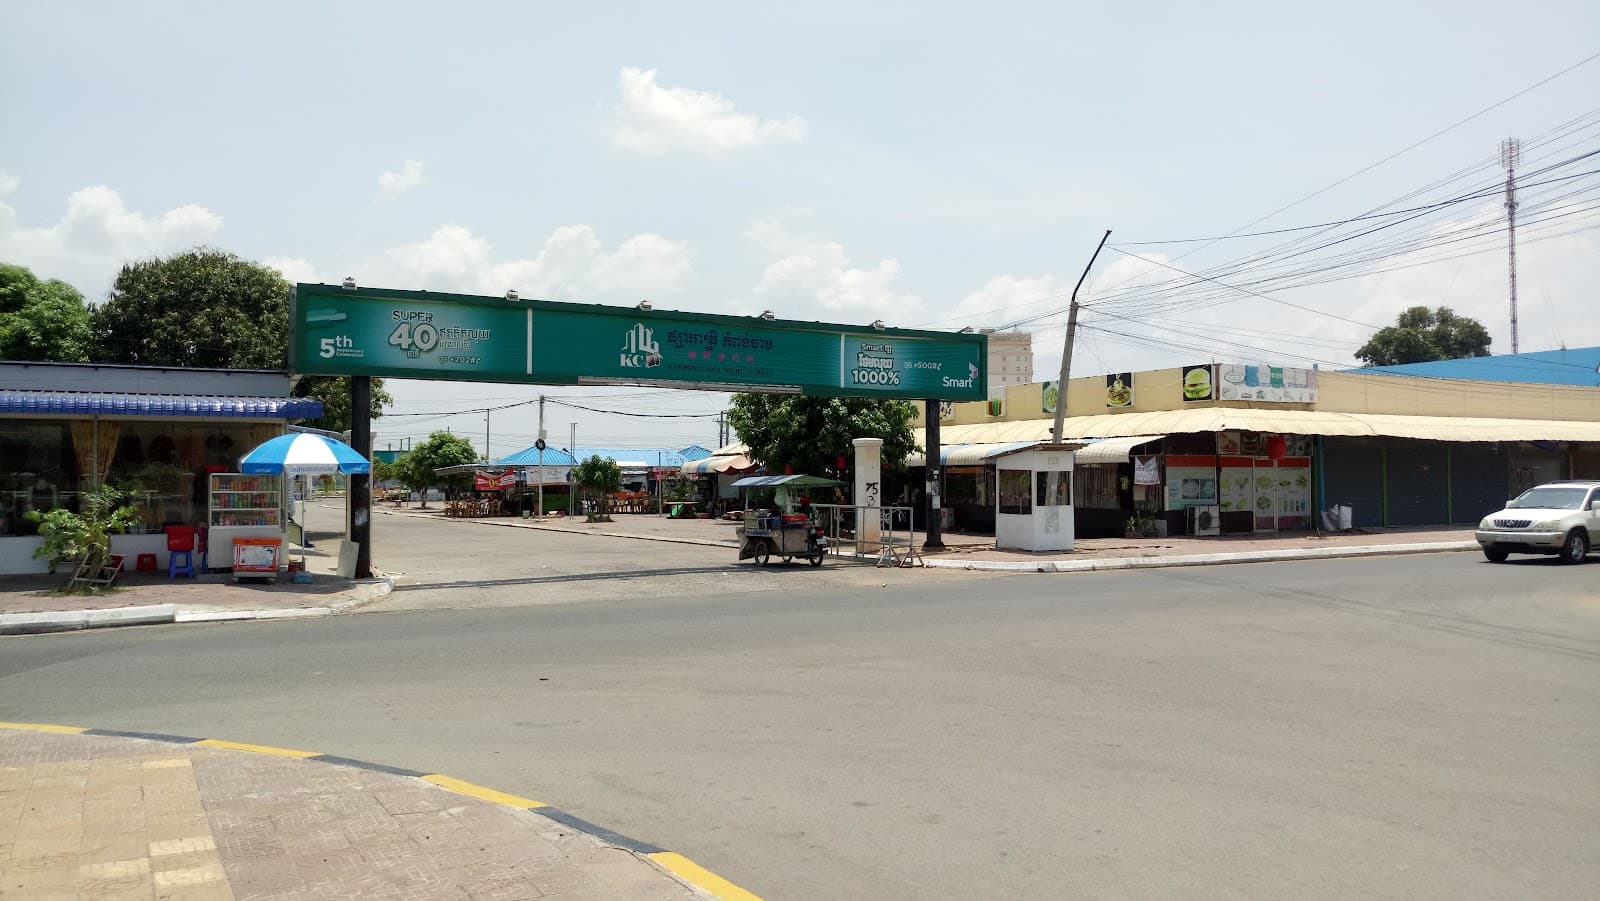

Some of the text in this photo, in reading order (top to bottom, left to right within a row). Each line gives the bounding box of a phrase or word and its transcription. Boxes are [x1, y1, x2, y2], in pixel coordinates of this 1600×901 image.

[392, 310, 434, 322] SUPER
[389, 323, 438, 350] 40
[320, 335, 353, 358] 5th
[861, 343, 883, 352] Smart
[852, 370, 899, 385] 1000%
[942, 376, 972, 387] Smart
